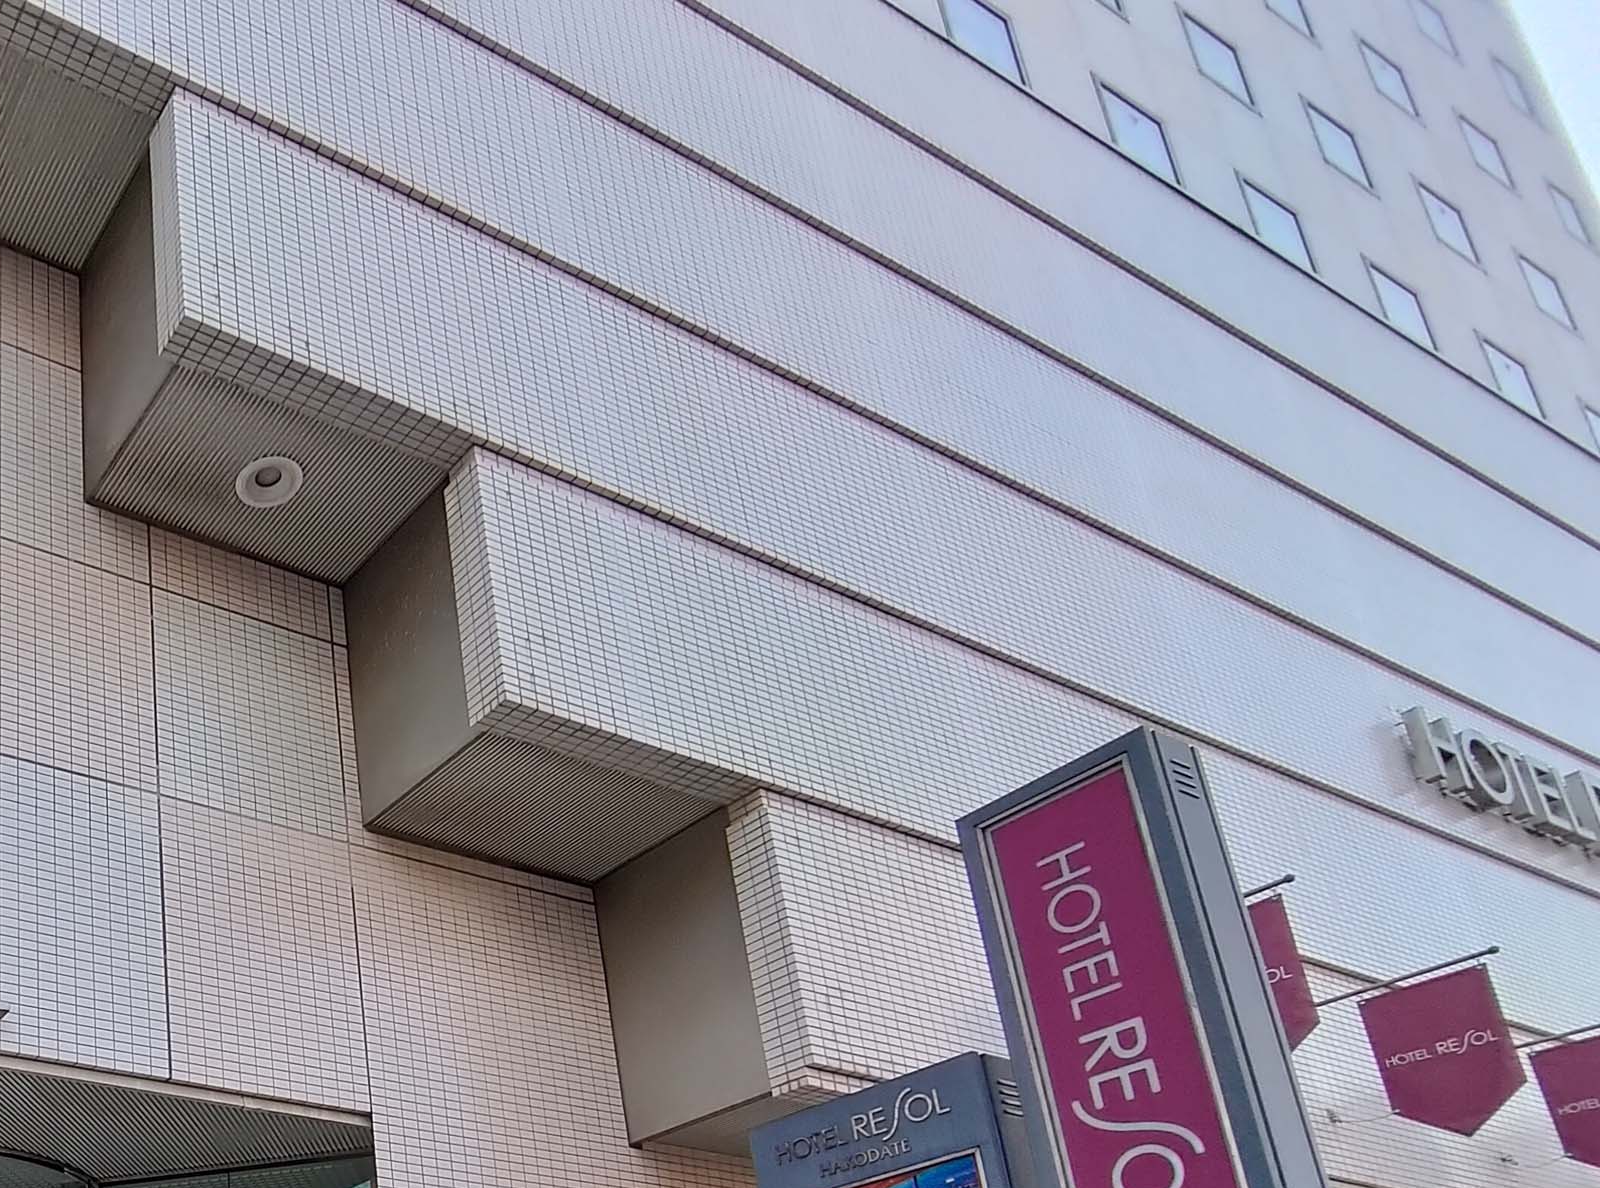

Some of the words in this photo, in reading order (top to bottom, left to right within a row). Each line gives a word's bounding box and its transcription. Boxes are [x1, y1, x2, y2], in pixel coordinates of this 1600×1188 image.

[1399, 705, 1597, 845] HOTEL
[1036, 841, 1123, 1022] HOTEL
[1385, 1048, 1432, 1068] HOTEL
[1435, 1029, 1499, 1054] RESOL
[776, 1124, 849, 1166] HOTEL
[851, 1087, 951, 1141] RESOL
[820, 1138, 911, 1179] HAKODATE
